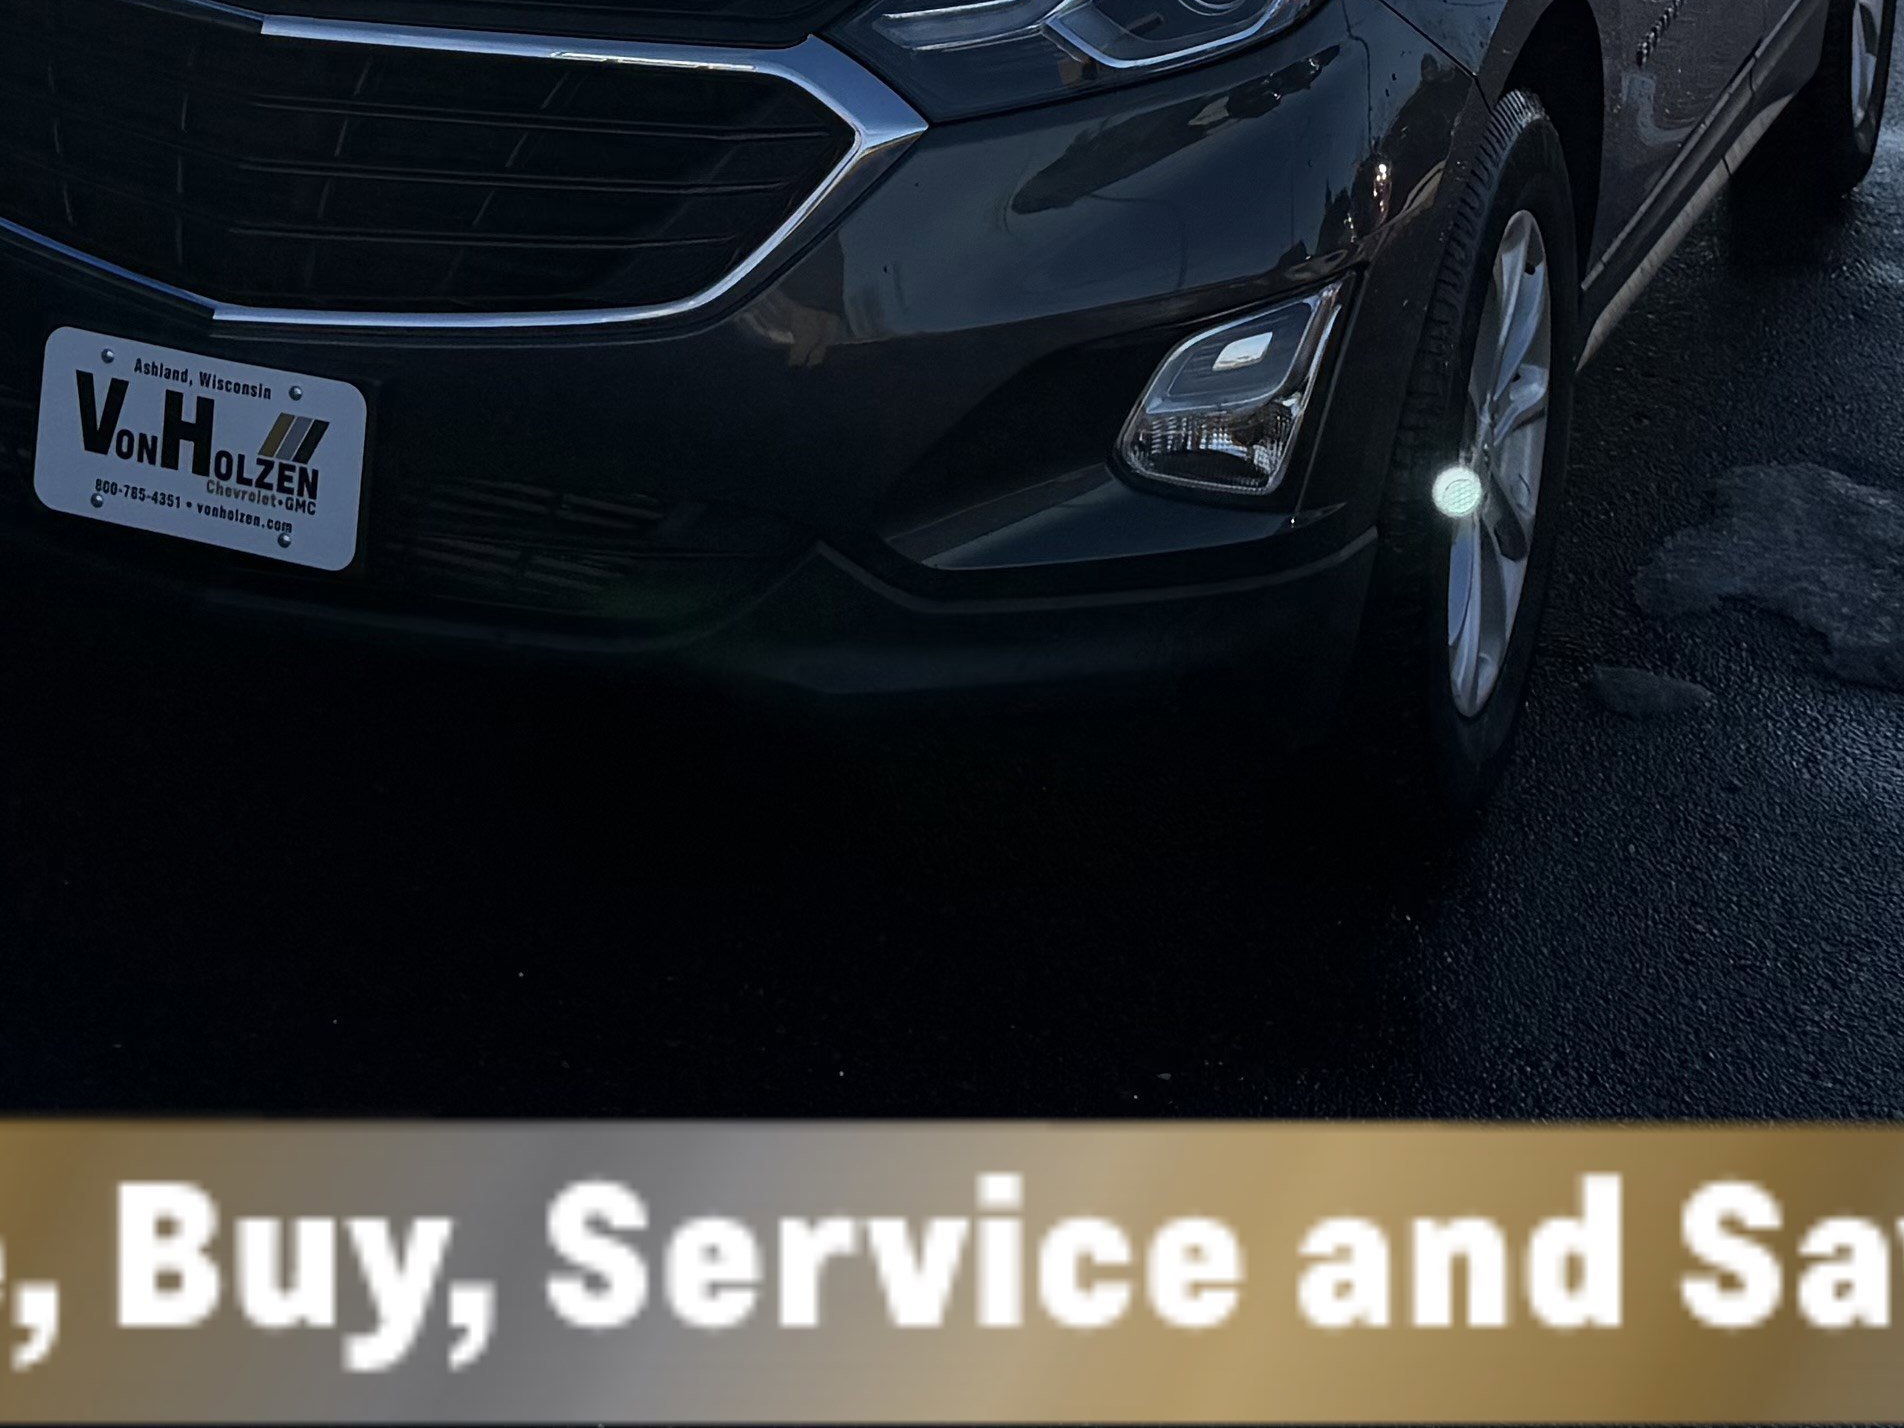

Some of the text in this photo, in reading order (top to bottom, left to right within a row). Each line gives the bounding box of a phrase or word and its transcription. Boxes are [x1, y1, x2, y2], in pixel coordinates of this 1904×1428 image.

[133, 357, 273, 401] Ashland, Wisconsin
[94, 477, 294, 534] 800-785-4351 vonholzen.com
